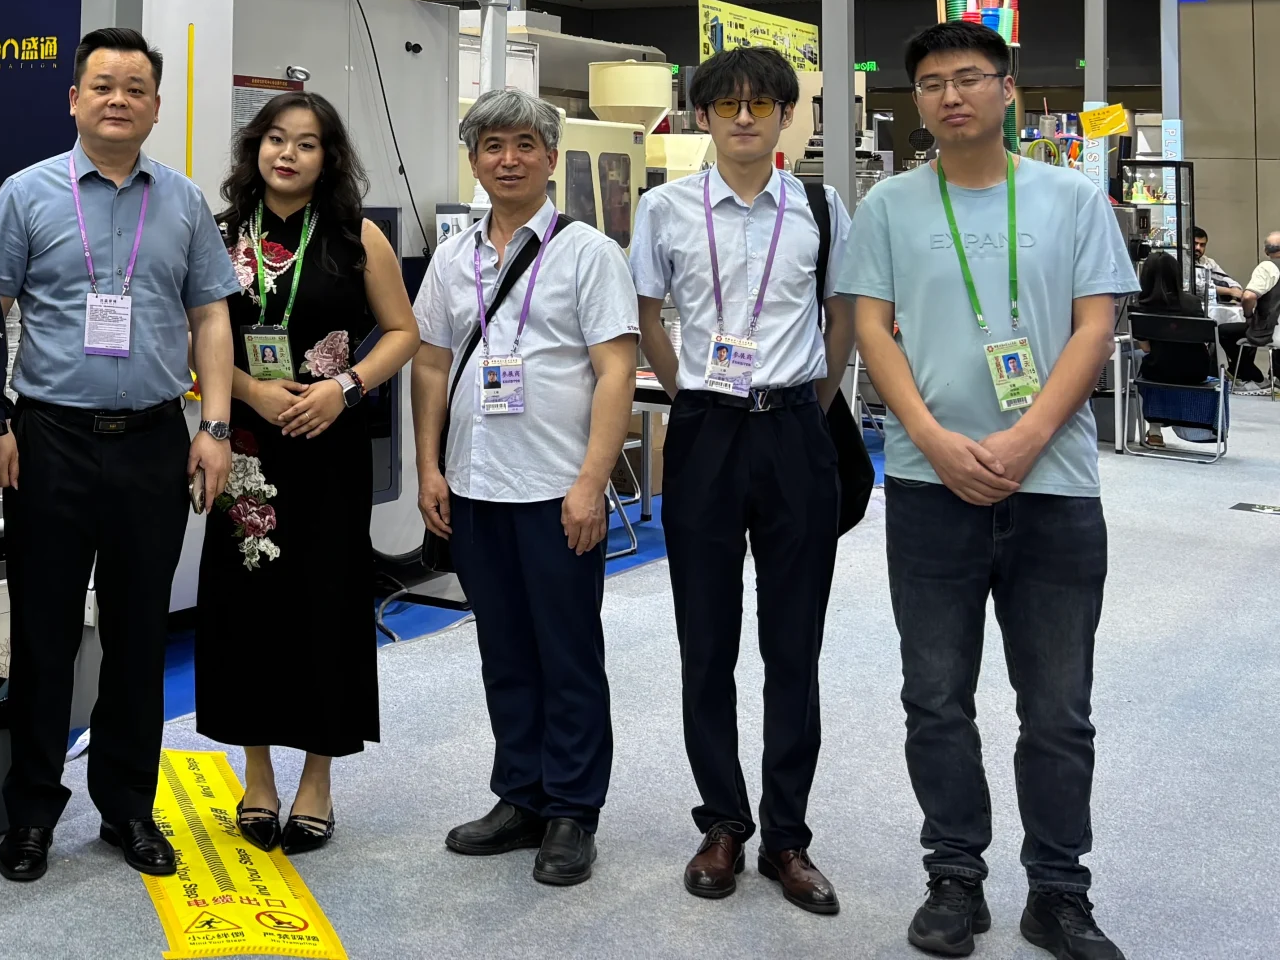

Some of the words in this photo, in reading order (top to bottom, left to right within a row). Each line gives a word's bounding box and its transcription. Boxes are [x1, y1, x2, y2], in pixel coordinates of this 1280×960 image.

[177, 866, 191, 882] Your
[187, 894, 287, 908] 电缆出口
